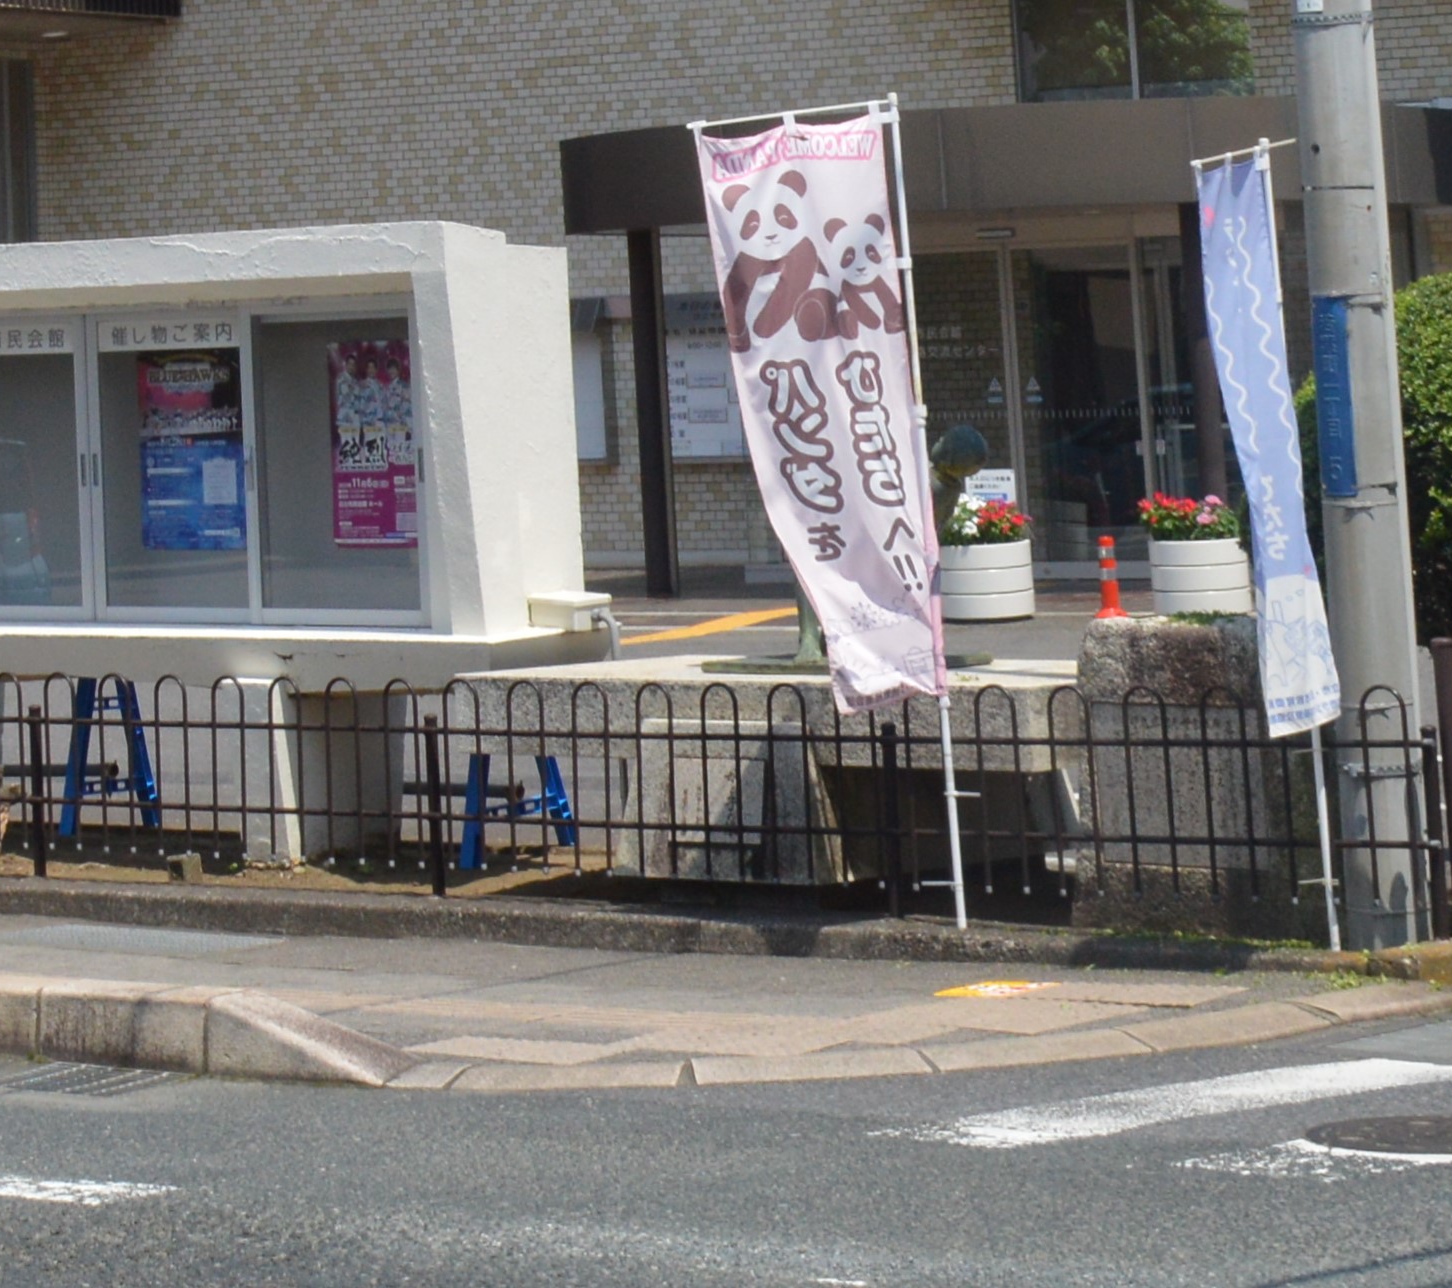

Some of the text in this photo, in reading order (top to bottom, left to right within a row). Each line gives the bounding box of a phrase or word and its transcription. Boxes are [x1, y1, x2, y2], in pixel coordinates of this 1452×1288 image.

[110, 322, 233, 347] 催し物ご案内
